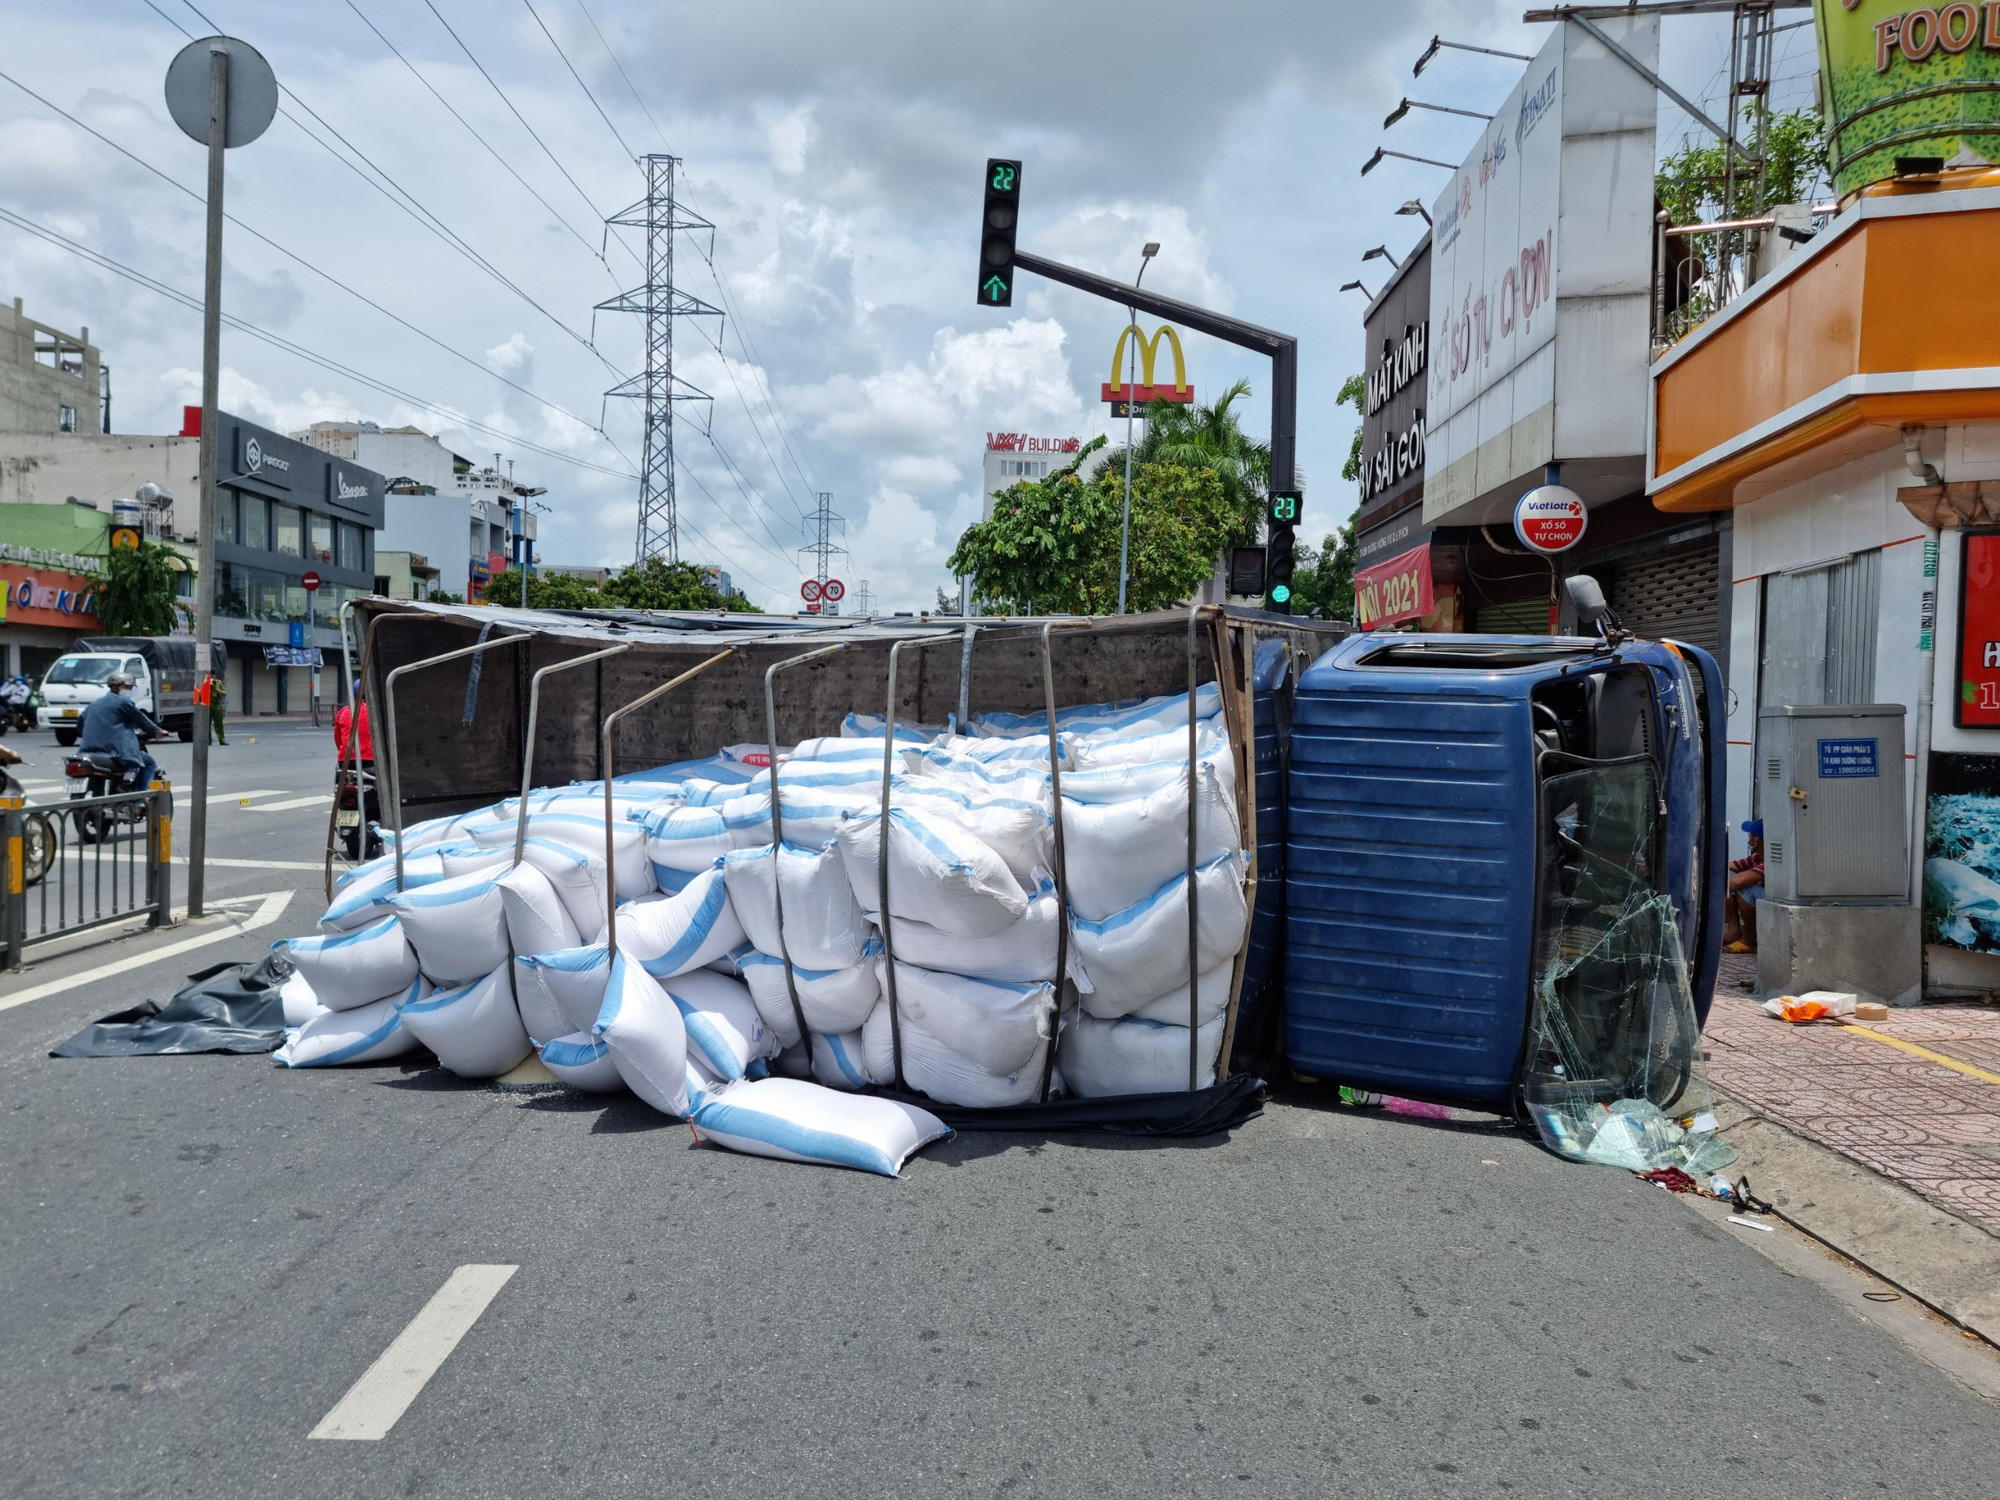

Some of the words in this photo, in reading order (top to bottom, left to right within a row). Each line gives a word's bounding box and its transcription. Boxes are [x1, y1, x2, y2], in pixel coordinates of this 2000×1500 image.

[993, 166, 1014, 190] 22
[1394, 321, 1426, 394] KÍNH
[1029, 437, 1080, 453] BUILDING
[1359, 456, 1375, 504] BV
[1375, 432, 1395, 493] SÀI
[337, 471, 369, 499] Vespa
[1274, 497, 1295, 518] 23
[1529, 502, 1568, 510] Vietlott
[1554, 520, 1566, 529] SỐ
[1535, 533, 1547, 541] TỰ
[1548, 532, 1572, 542] CHỌN
[830, 586, 839, 595] 70
[1383, 568, 1419, 617] 2021
[1838, 766, 1875, 774] 1900545454
